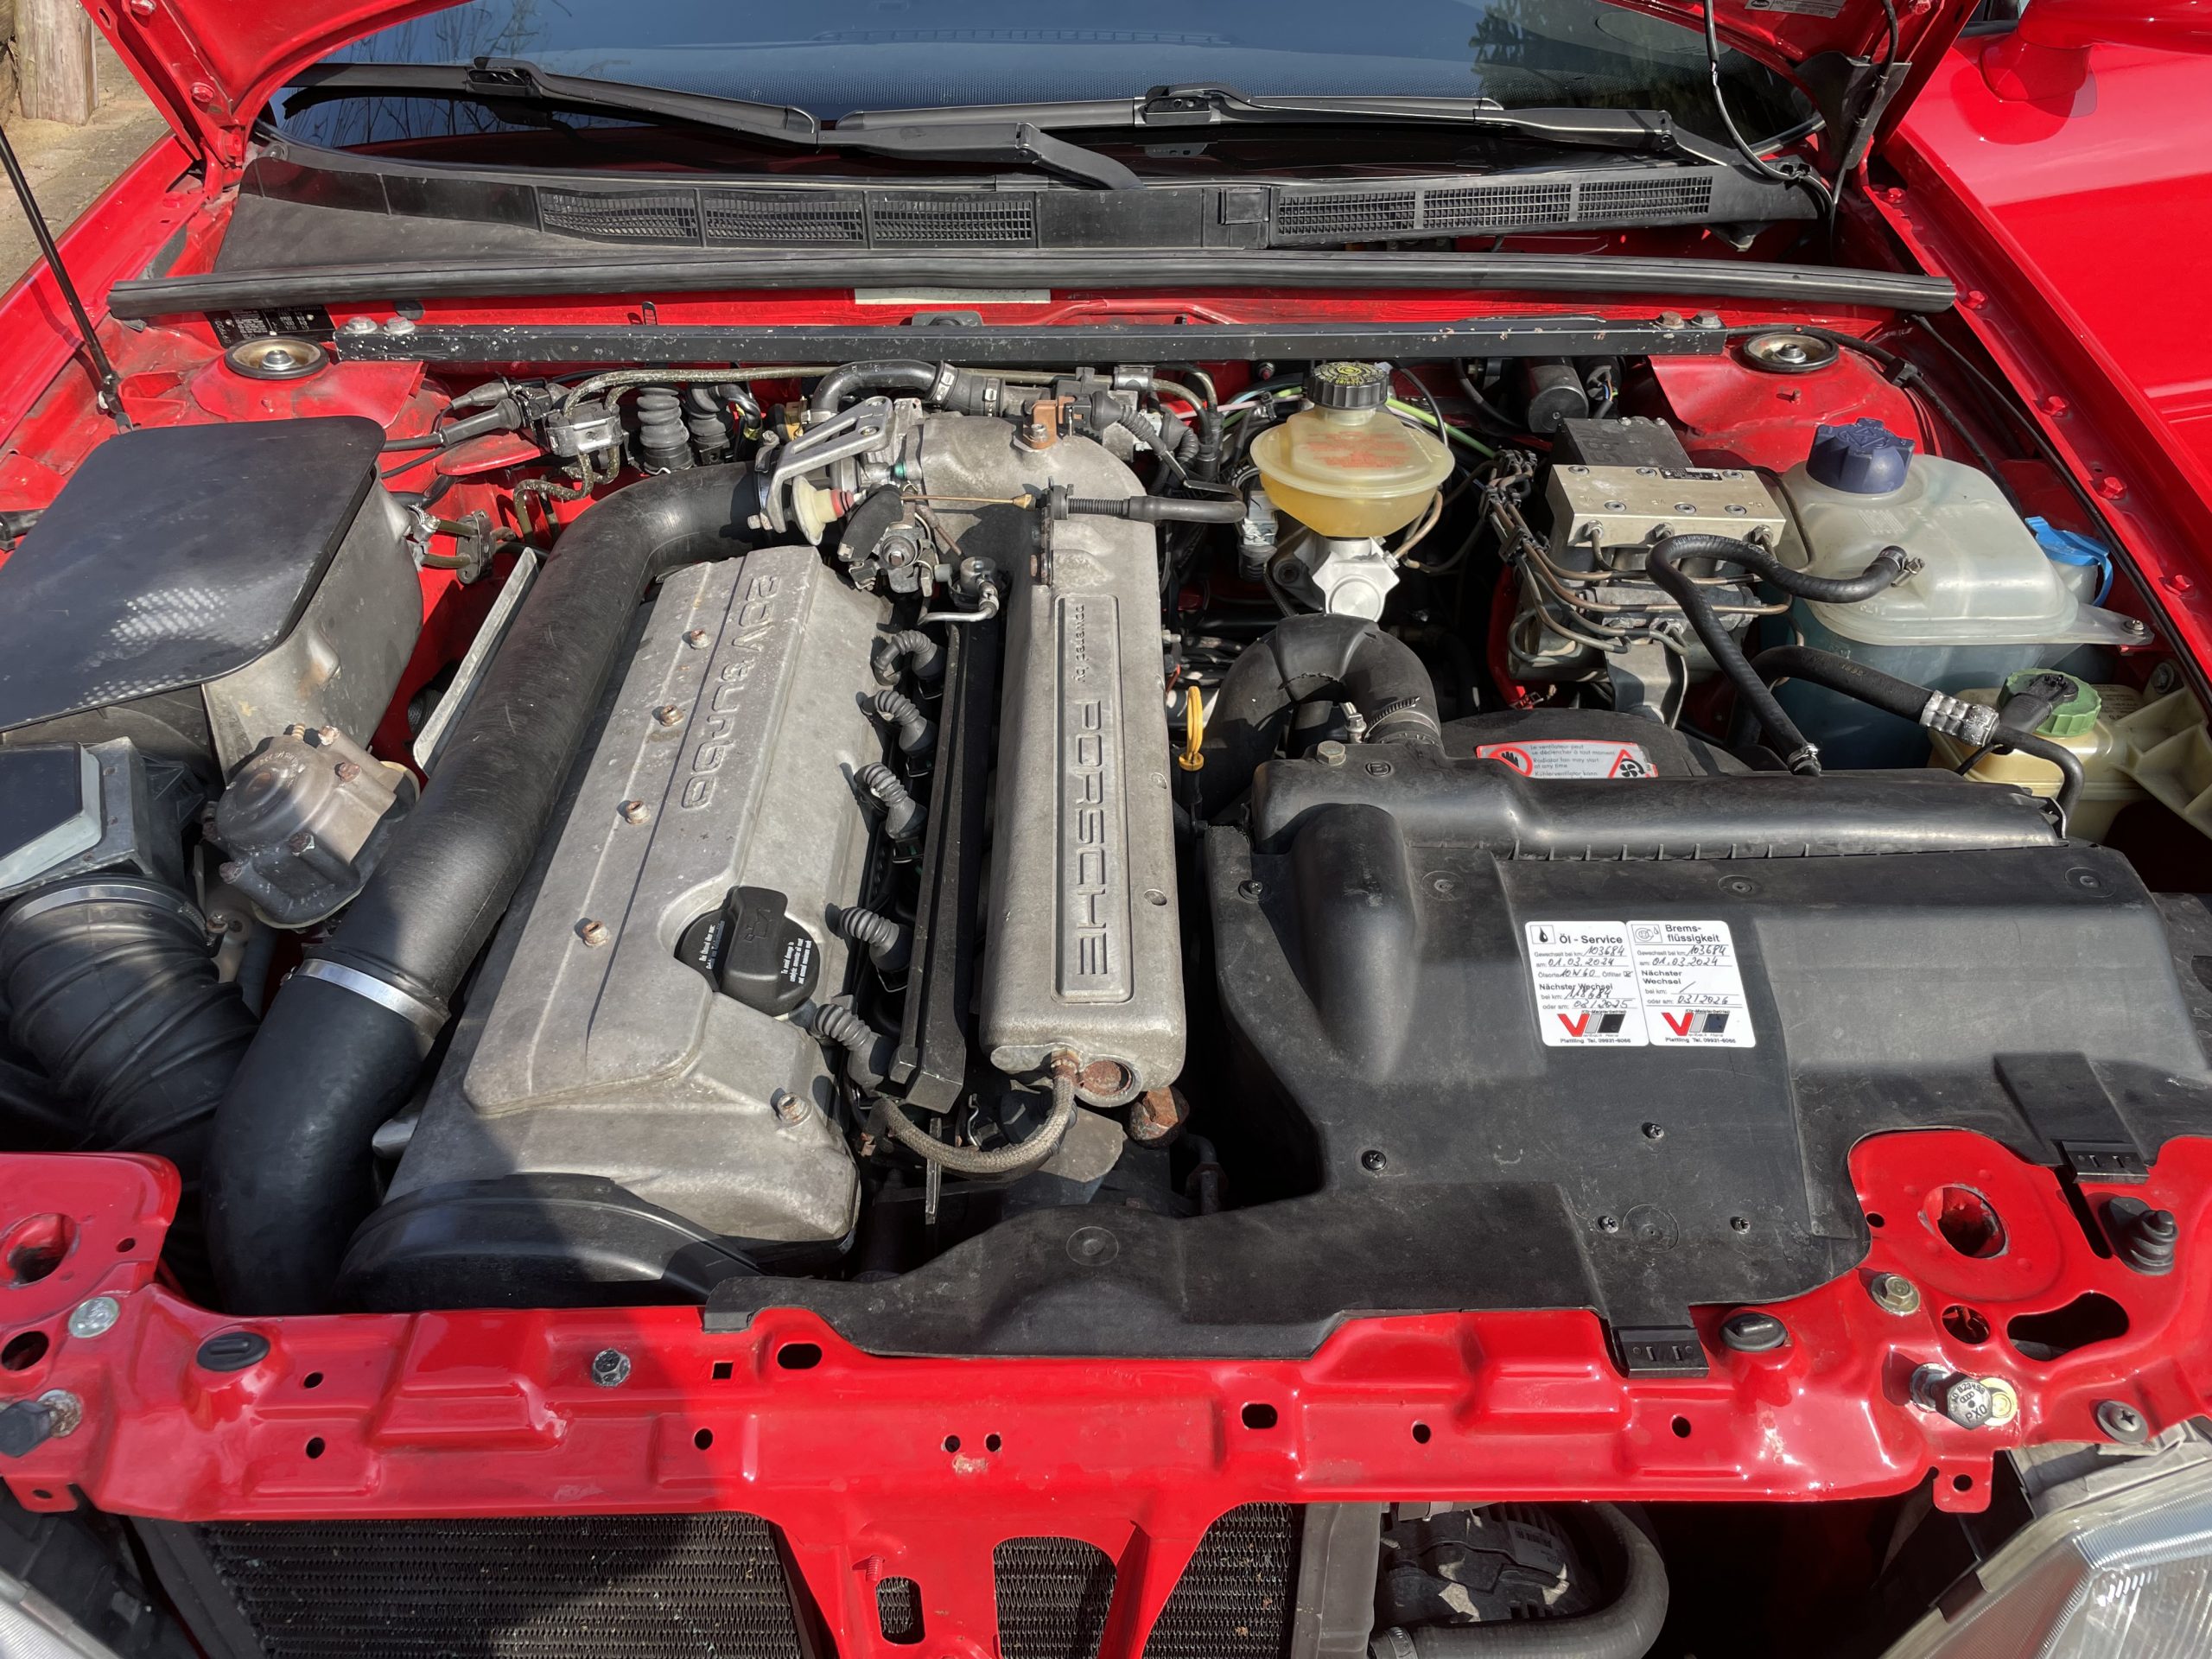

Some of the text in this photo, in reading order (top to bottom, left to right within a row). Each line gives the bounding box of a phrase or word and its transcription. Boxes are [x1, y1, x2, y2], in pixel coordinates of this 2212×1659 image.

[732, 574, 782, 652] 20V
[1072, 604, 1089, 683] powered by
[1074, 698, 1108, 976] PORSCHE
[1559, 932, 1572, 944] Öl
[1580, 935, 1624, 944] Service
[1667, 933, 1720, 944] flüssigkeit
